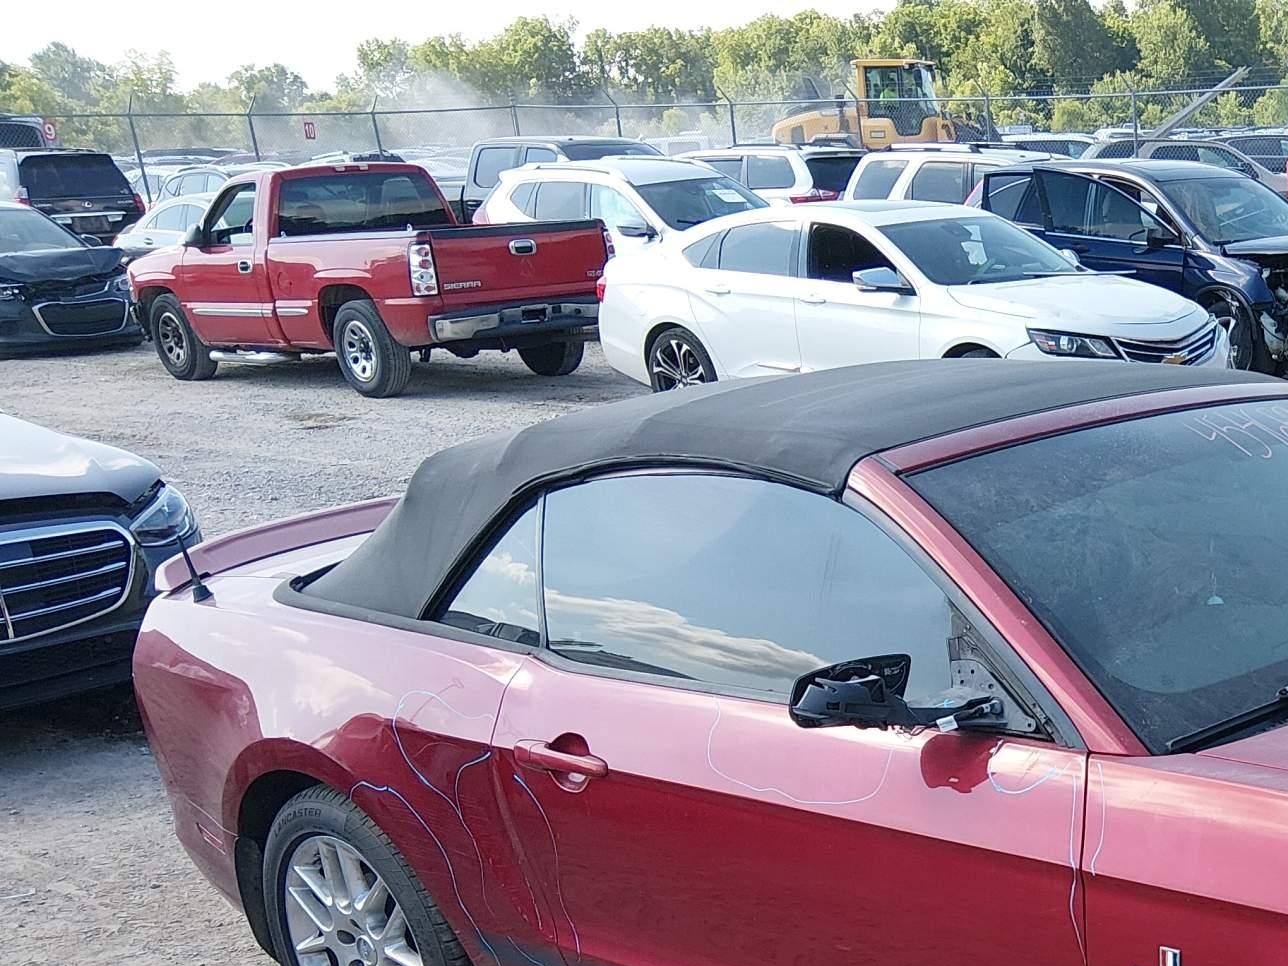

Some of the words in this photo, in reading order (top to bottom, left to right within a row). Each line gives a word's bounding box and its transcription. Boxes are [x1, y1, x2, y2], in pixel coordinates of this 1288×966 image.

[44, 123, 55, 140] 9
[305, 123, 315, 138] 10
[274, 807, 322, 838] LANCASTER
